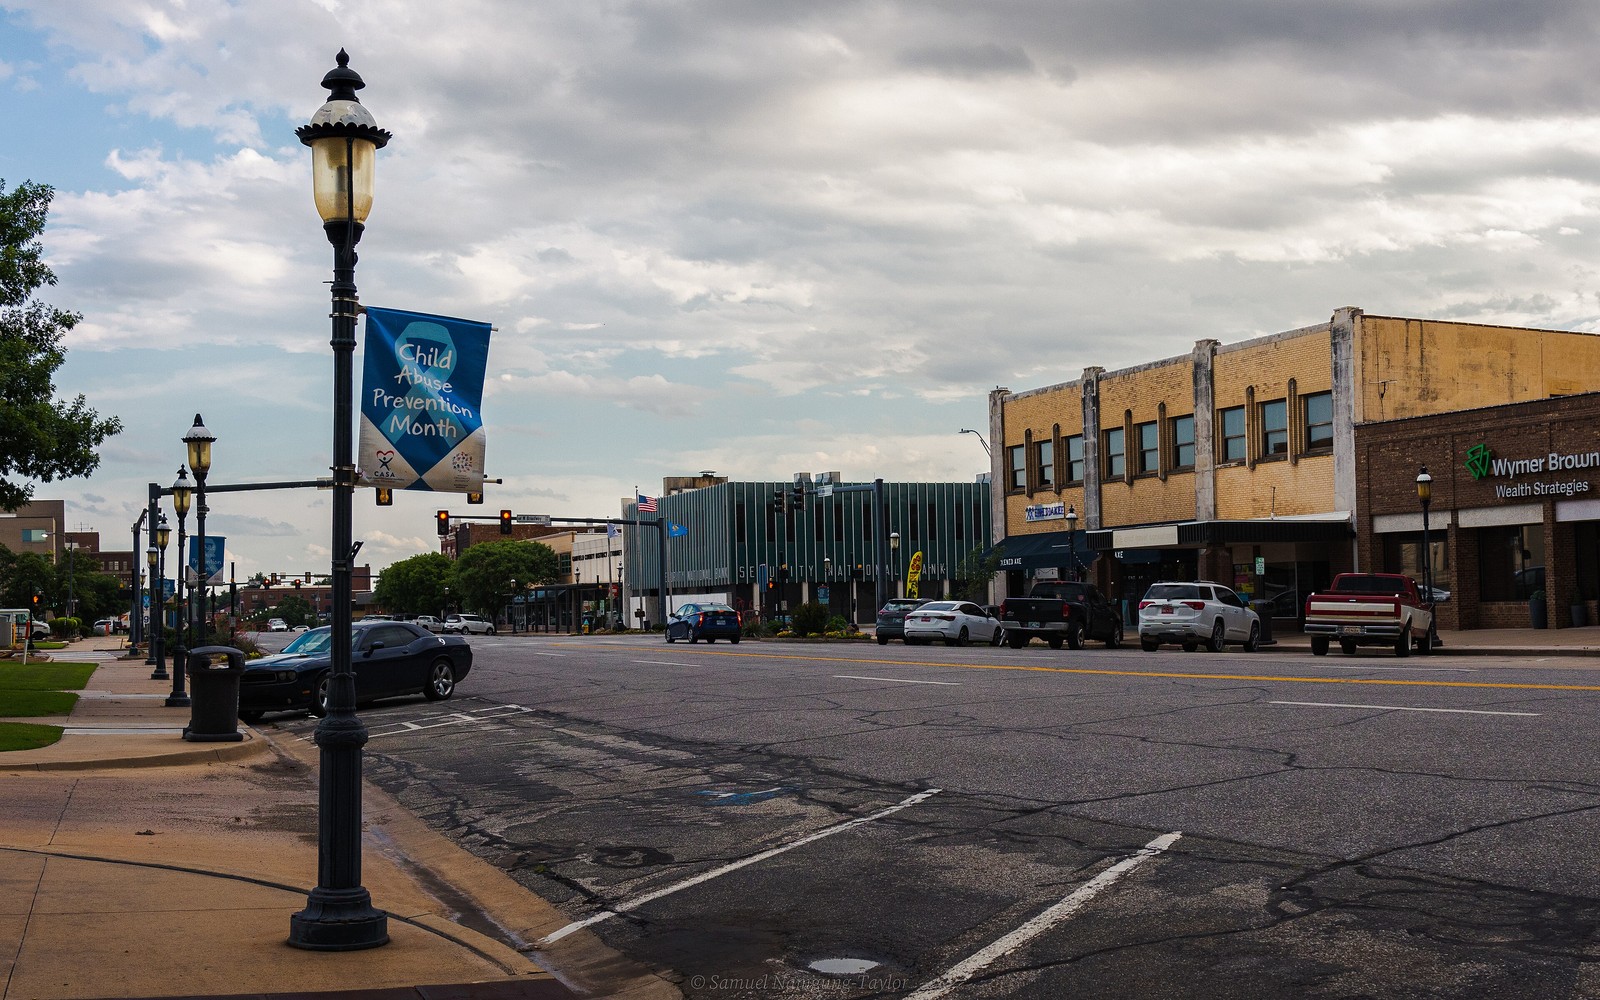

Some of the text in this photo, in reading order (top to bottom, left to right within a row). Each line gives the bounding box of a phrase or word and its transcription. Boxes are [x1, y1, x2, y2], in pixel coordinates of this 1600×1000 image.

[399, 343, 453, 370] Child
[394, 364, 453, 393] Abuse
[373, 388, 473, 419] Prevention
[389, 414, 457, 438] Month
[1492, 451, 1600, 479] Wymer Brown
[1496, 479, 1589, 498] Wealth Strategies
[739, 561, 946, 578] SEUITY NATONAL ANK
